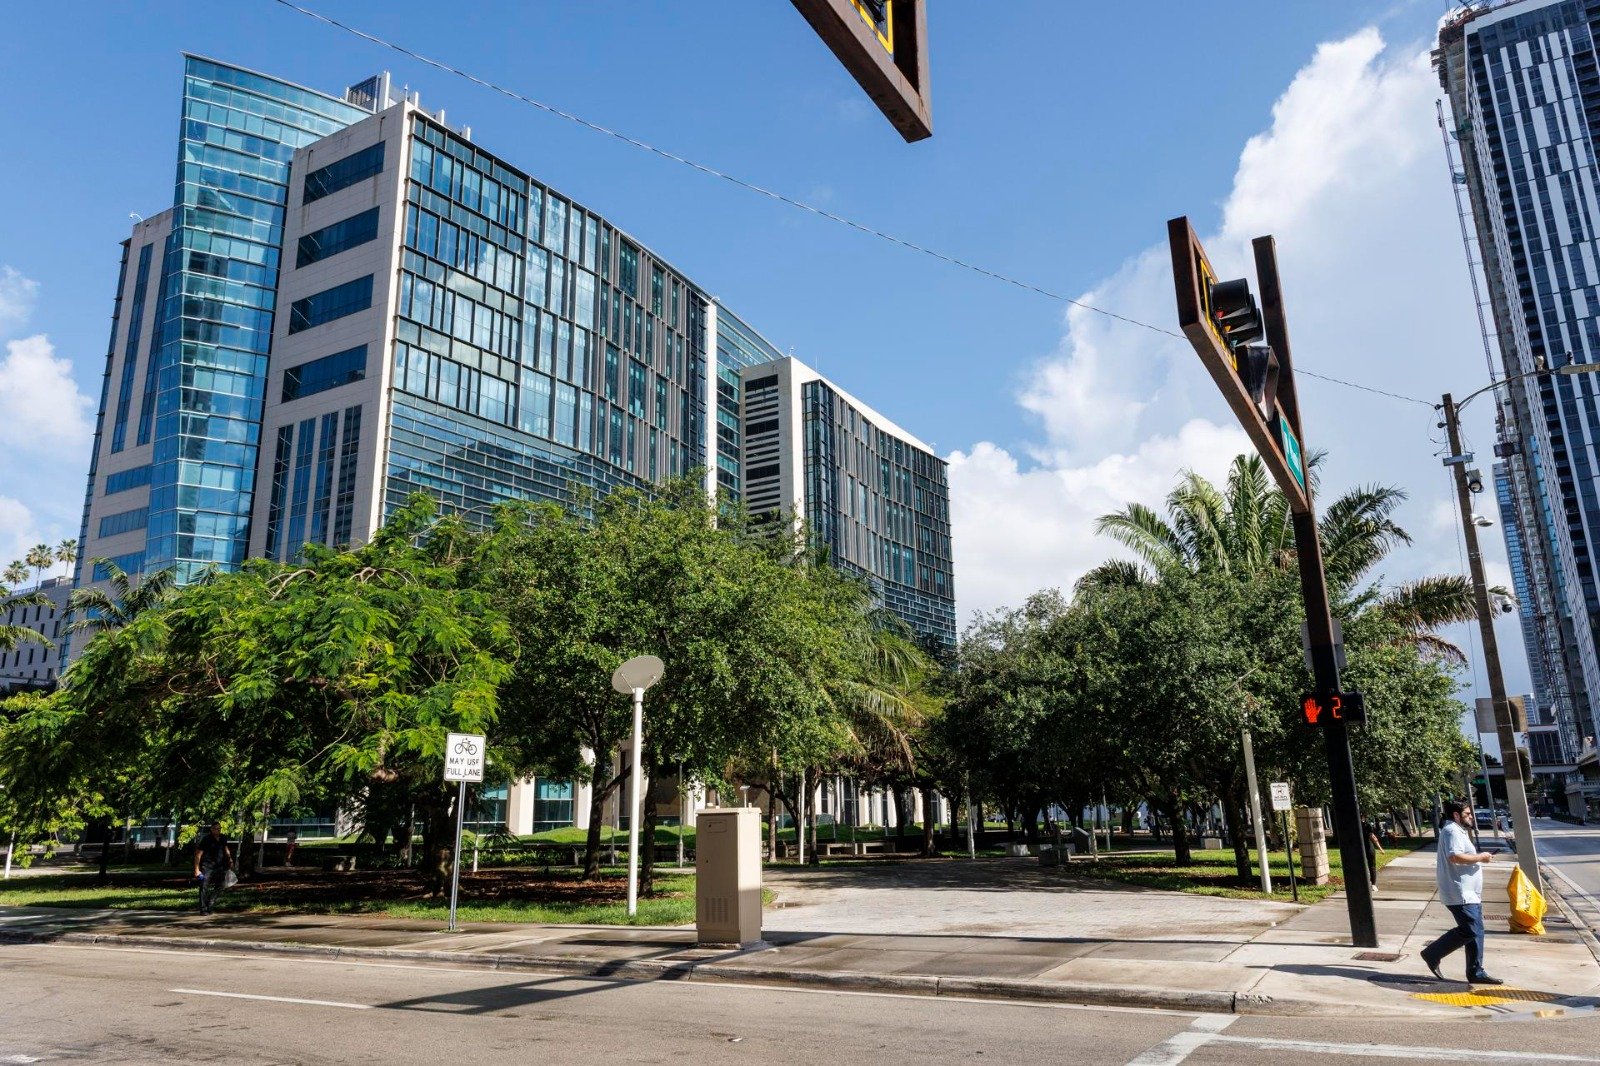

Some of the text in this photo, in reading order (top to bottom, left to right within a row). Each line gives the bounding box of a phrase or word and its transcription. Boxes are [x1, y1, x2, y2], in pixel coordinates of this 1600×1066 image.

[1331, 697, 1342, 719] 2
[449, 757, 465, 765] MAY
[446, 767, 481, 777] FULL LANE
